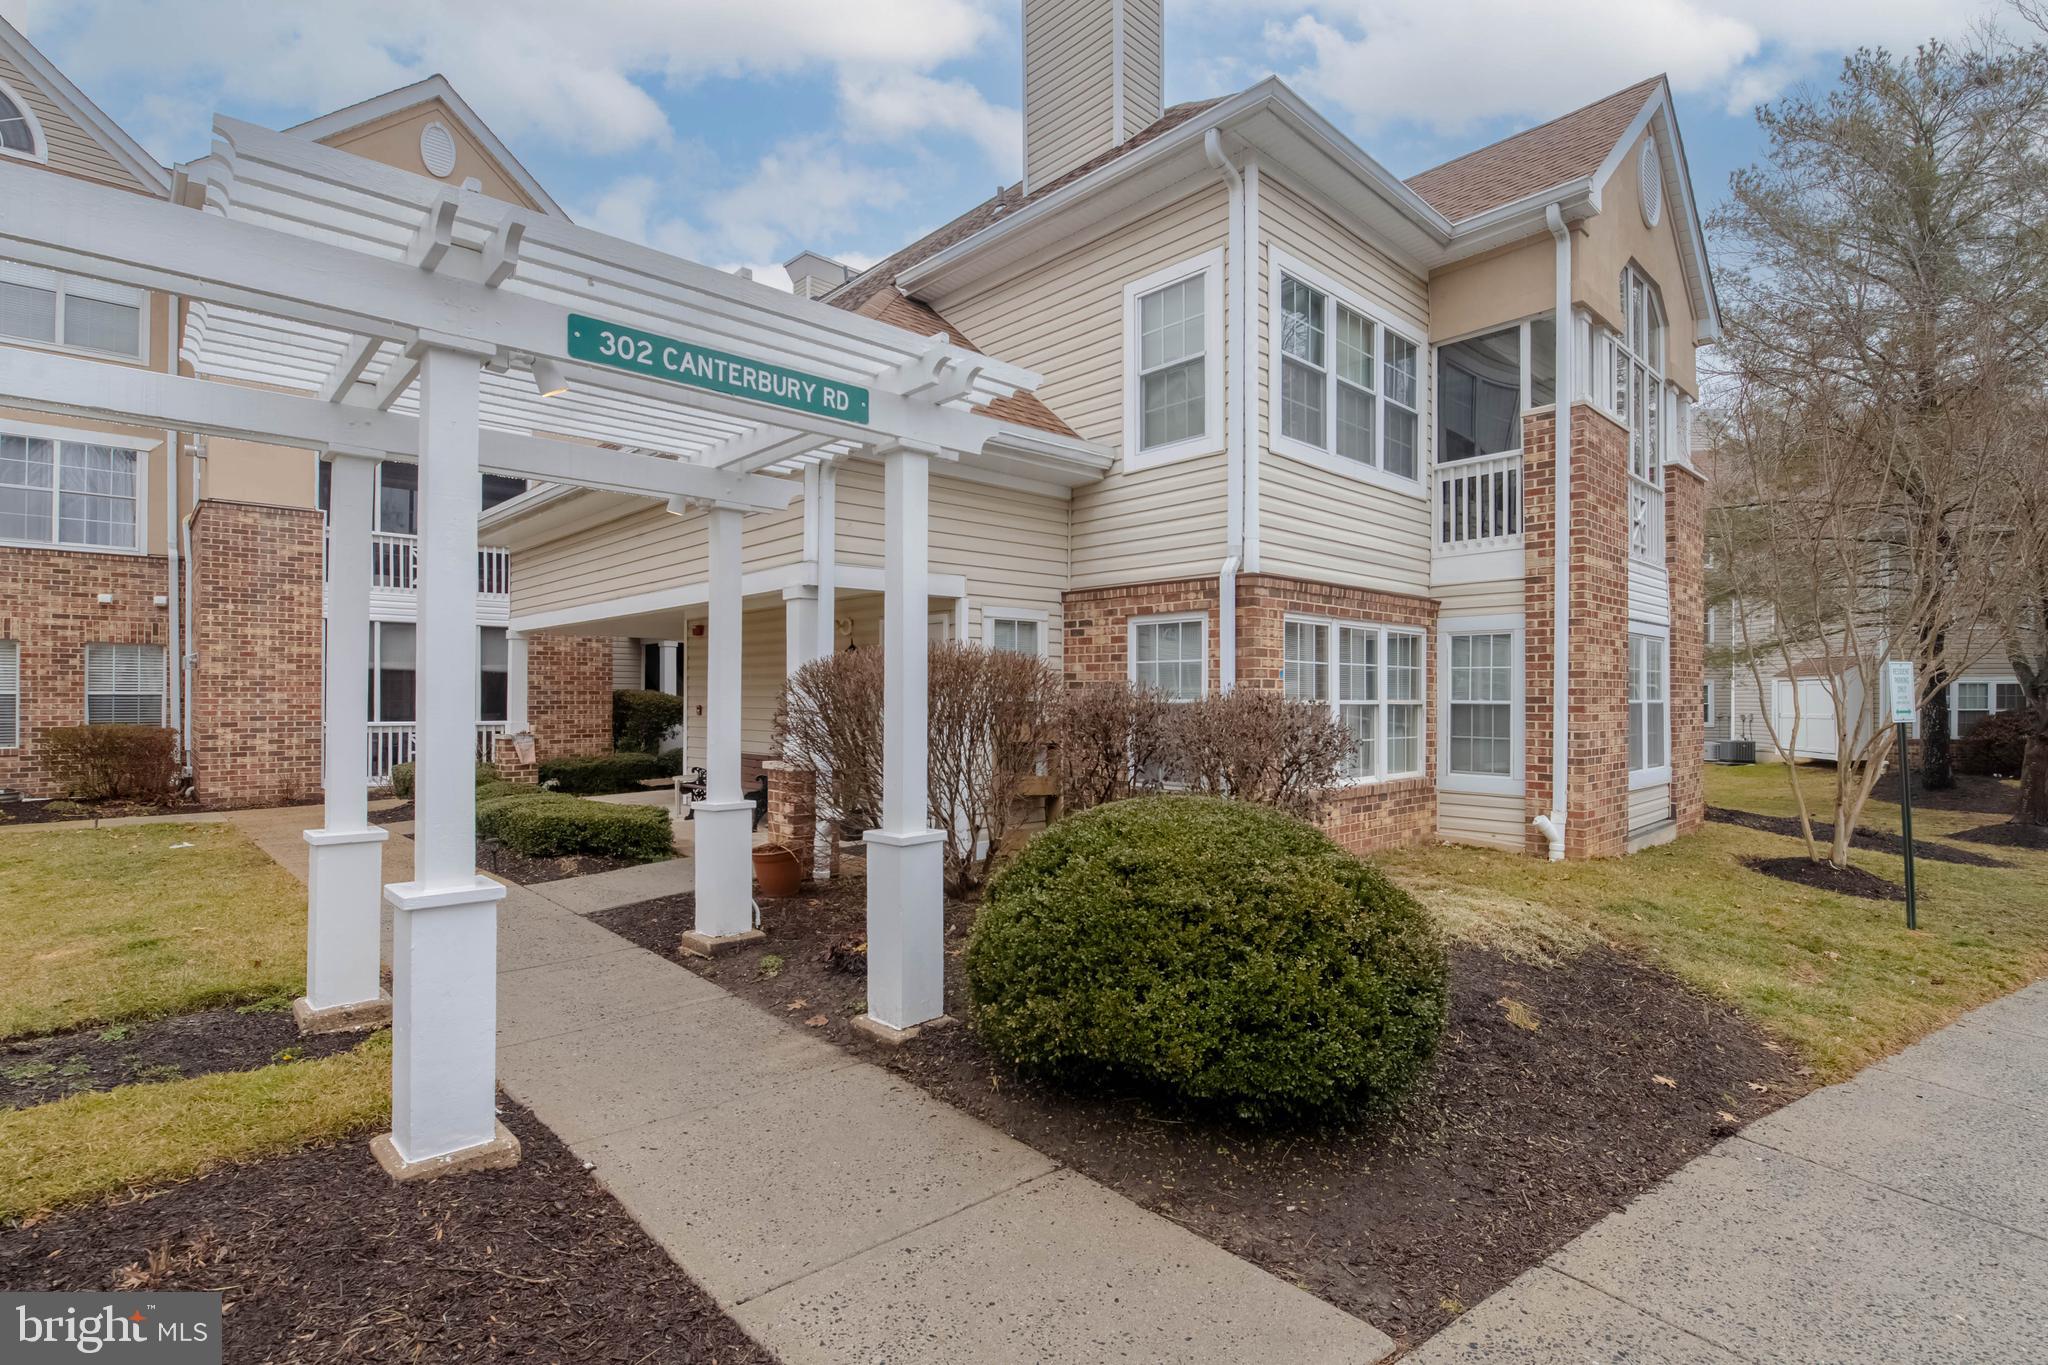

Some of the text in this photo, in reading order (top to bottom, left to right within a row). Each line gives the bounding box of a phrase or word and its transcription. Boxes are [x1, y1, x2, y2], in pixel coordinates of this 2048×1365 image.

[599, 331, 850, 412] 302 CANTERBURY RD
